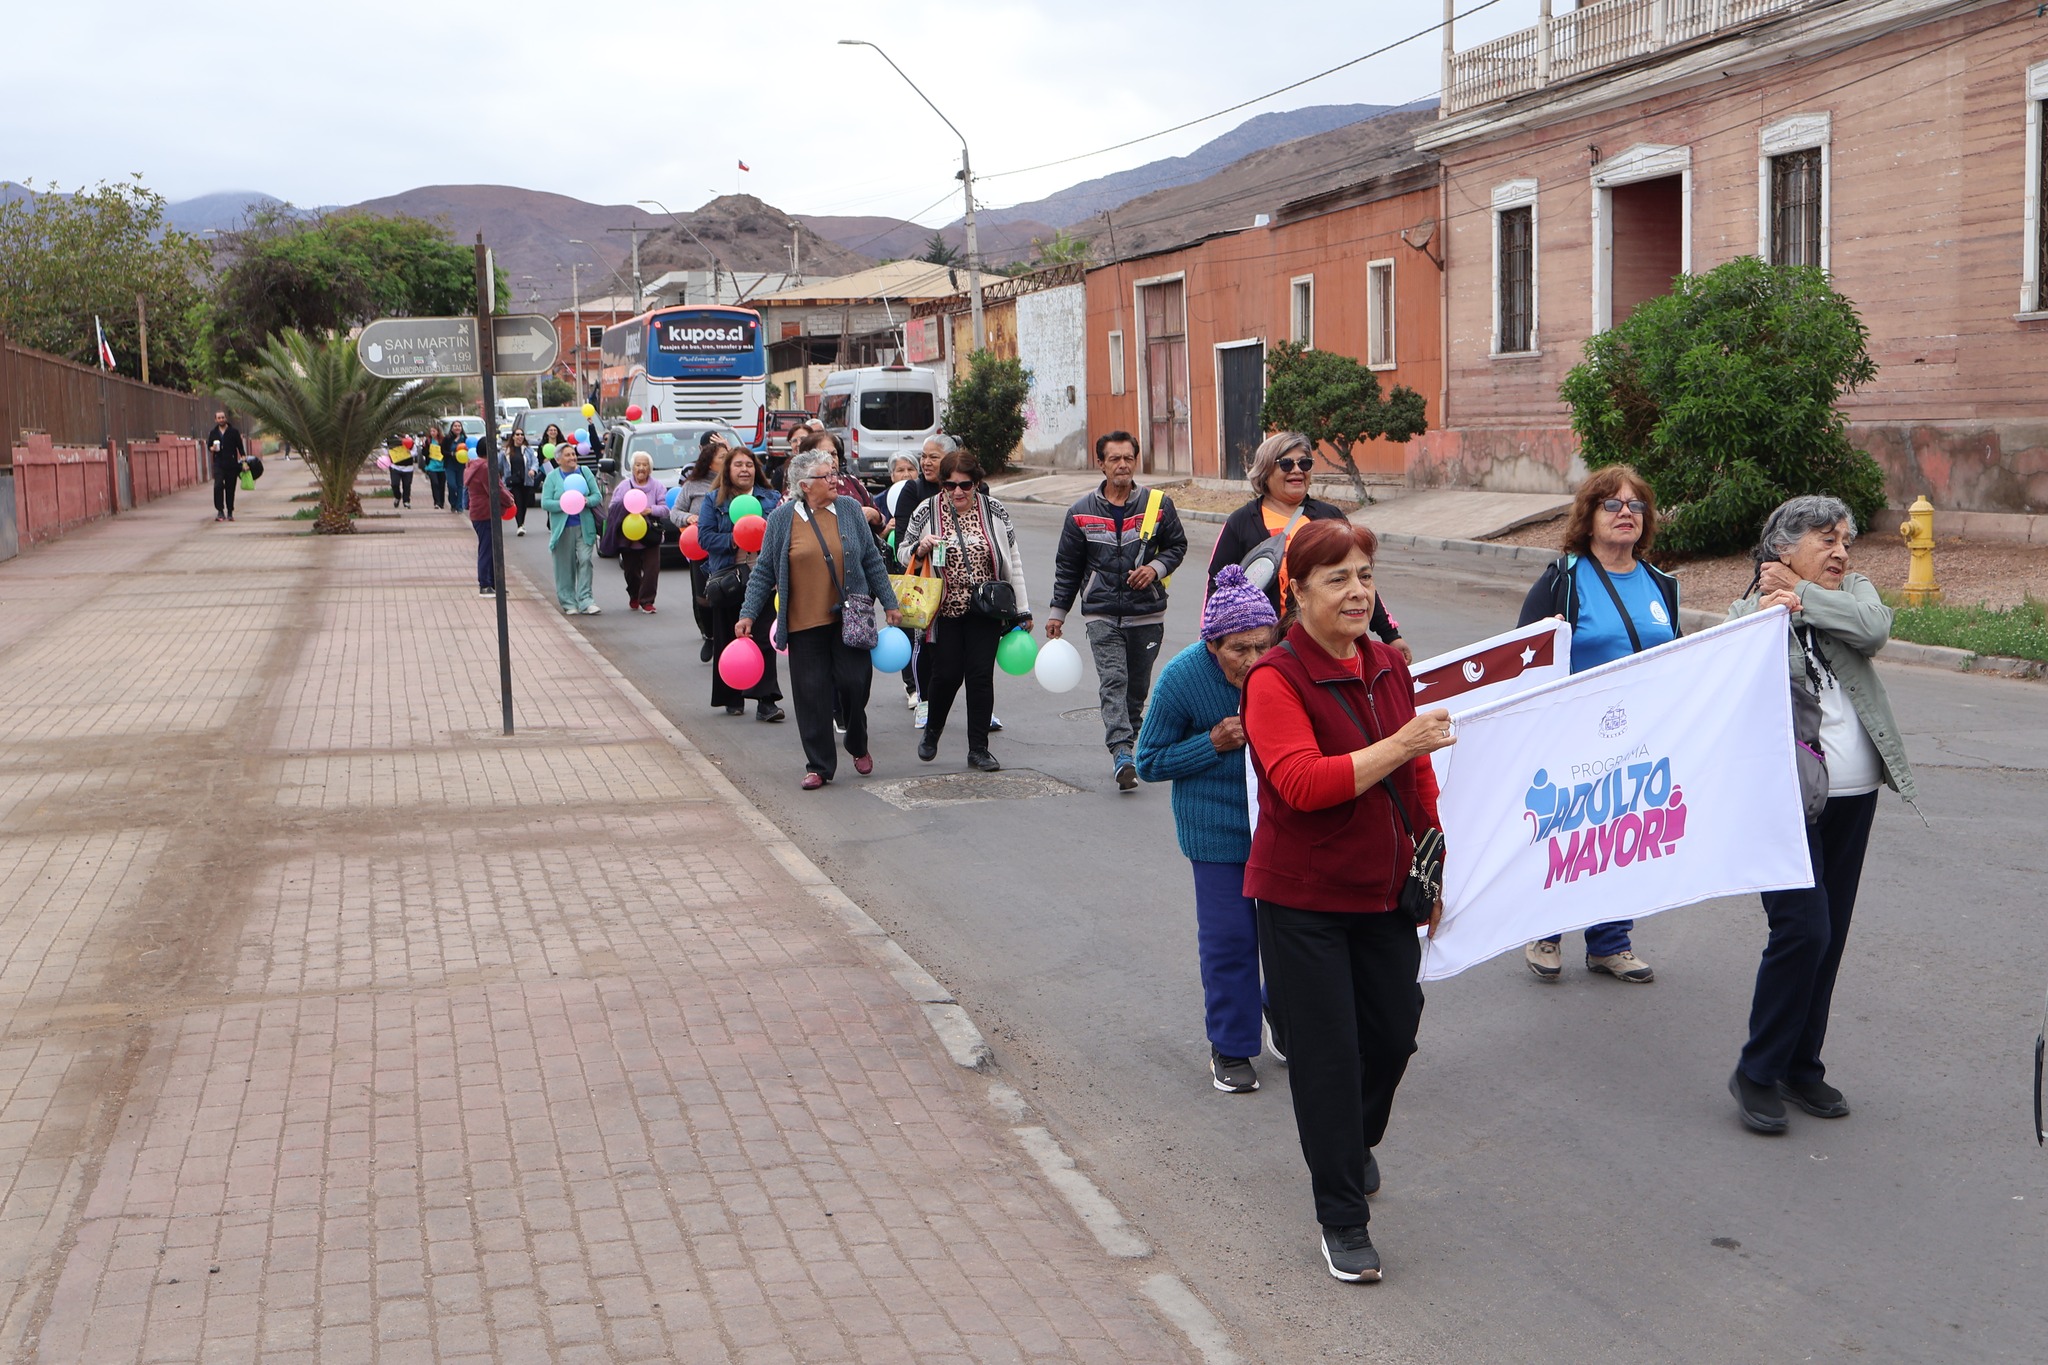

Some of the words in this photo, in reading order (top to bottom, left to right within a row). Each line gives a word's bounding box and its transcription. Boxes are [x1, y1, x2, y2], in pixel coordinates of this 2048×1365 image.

[669, 325, 743, 344] kupos.cl
[384, 338, 413, 351] SAN
[417, 336, 470, 350] MARTIN
[387, 354, 406, 365] 101
[453, 351, 472, 362] 199
[392, 365, 441, 375] MUNICIPALIDAD
[442, 364, 451, 373] DE
[452, 363, 473, 373] TALTAL
[1571, 744, 1650, 780] PROGRAMA
[1542, 756, 1672, 840] ADULTO
